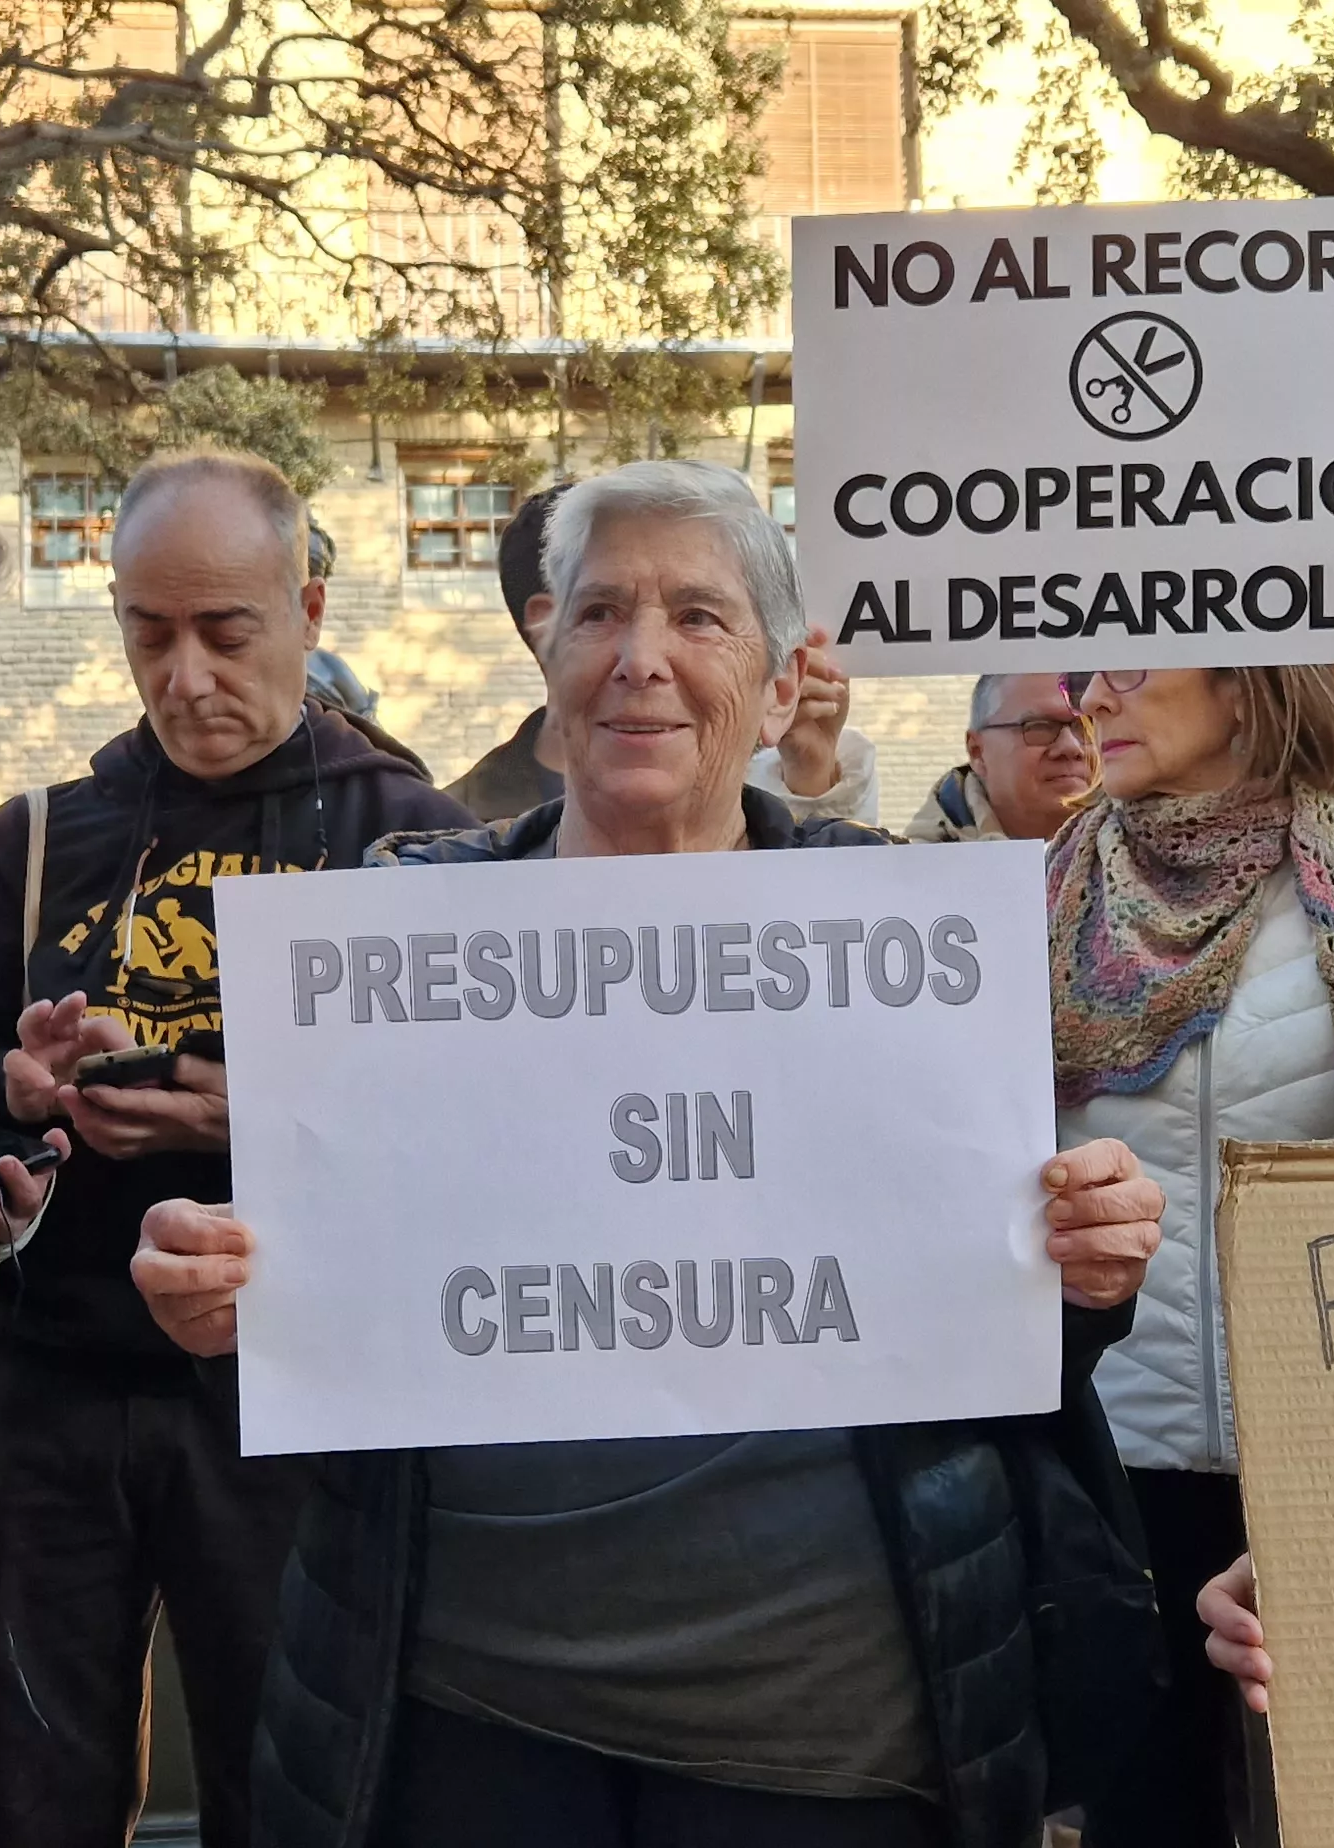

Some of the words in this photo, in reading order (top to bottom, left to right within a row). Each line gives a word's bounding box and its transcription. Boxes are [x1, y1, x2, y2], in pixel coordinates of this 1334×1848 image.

[833, 240, 956, 309] NO
[969, 236, 1071, 303] AL
[835, 580, 933, 646] AL
[289, 914, 982, 1027] PRESUPUESTOS
[608, 1090, 756, 1184] SIN
[440, 1255, 861, 1356] CENSURA
